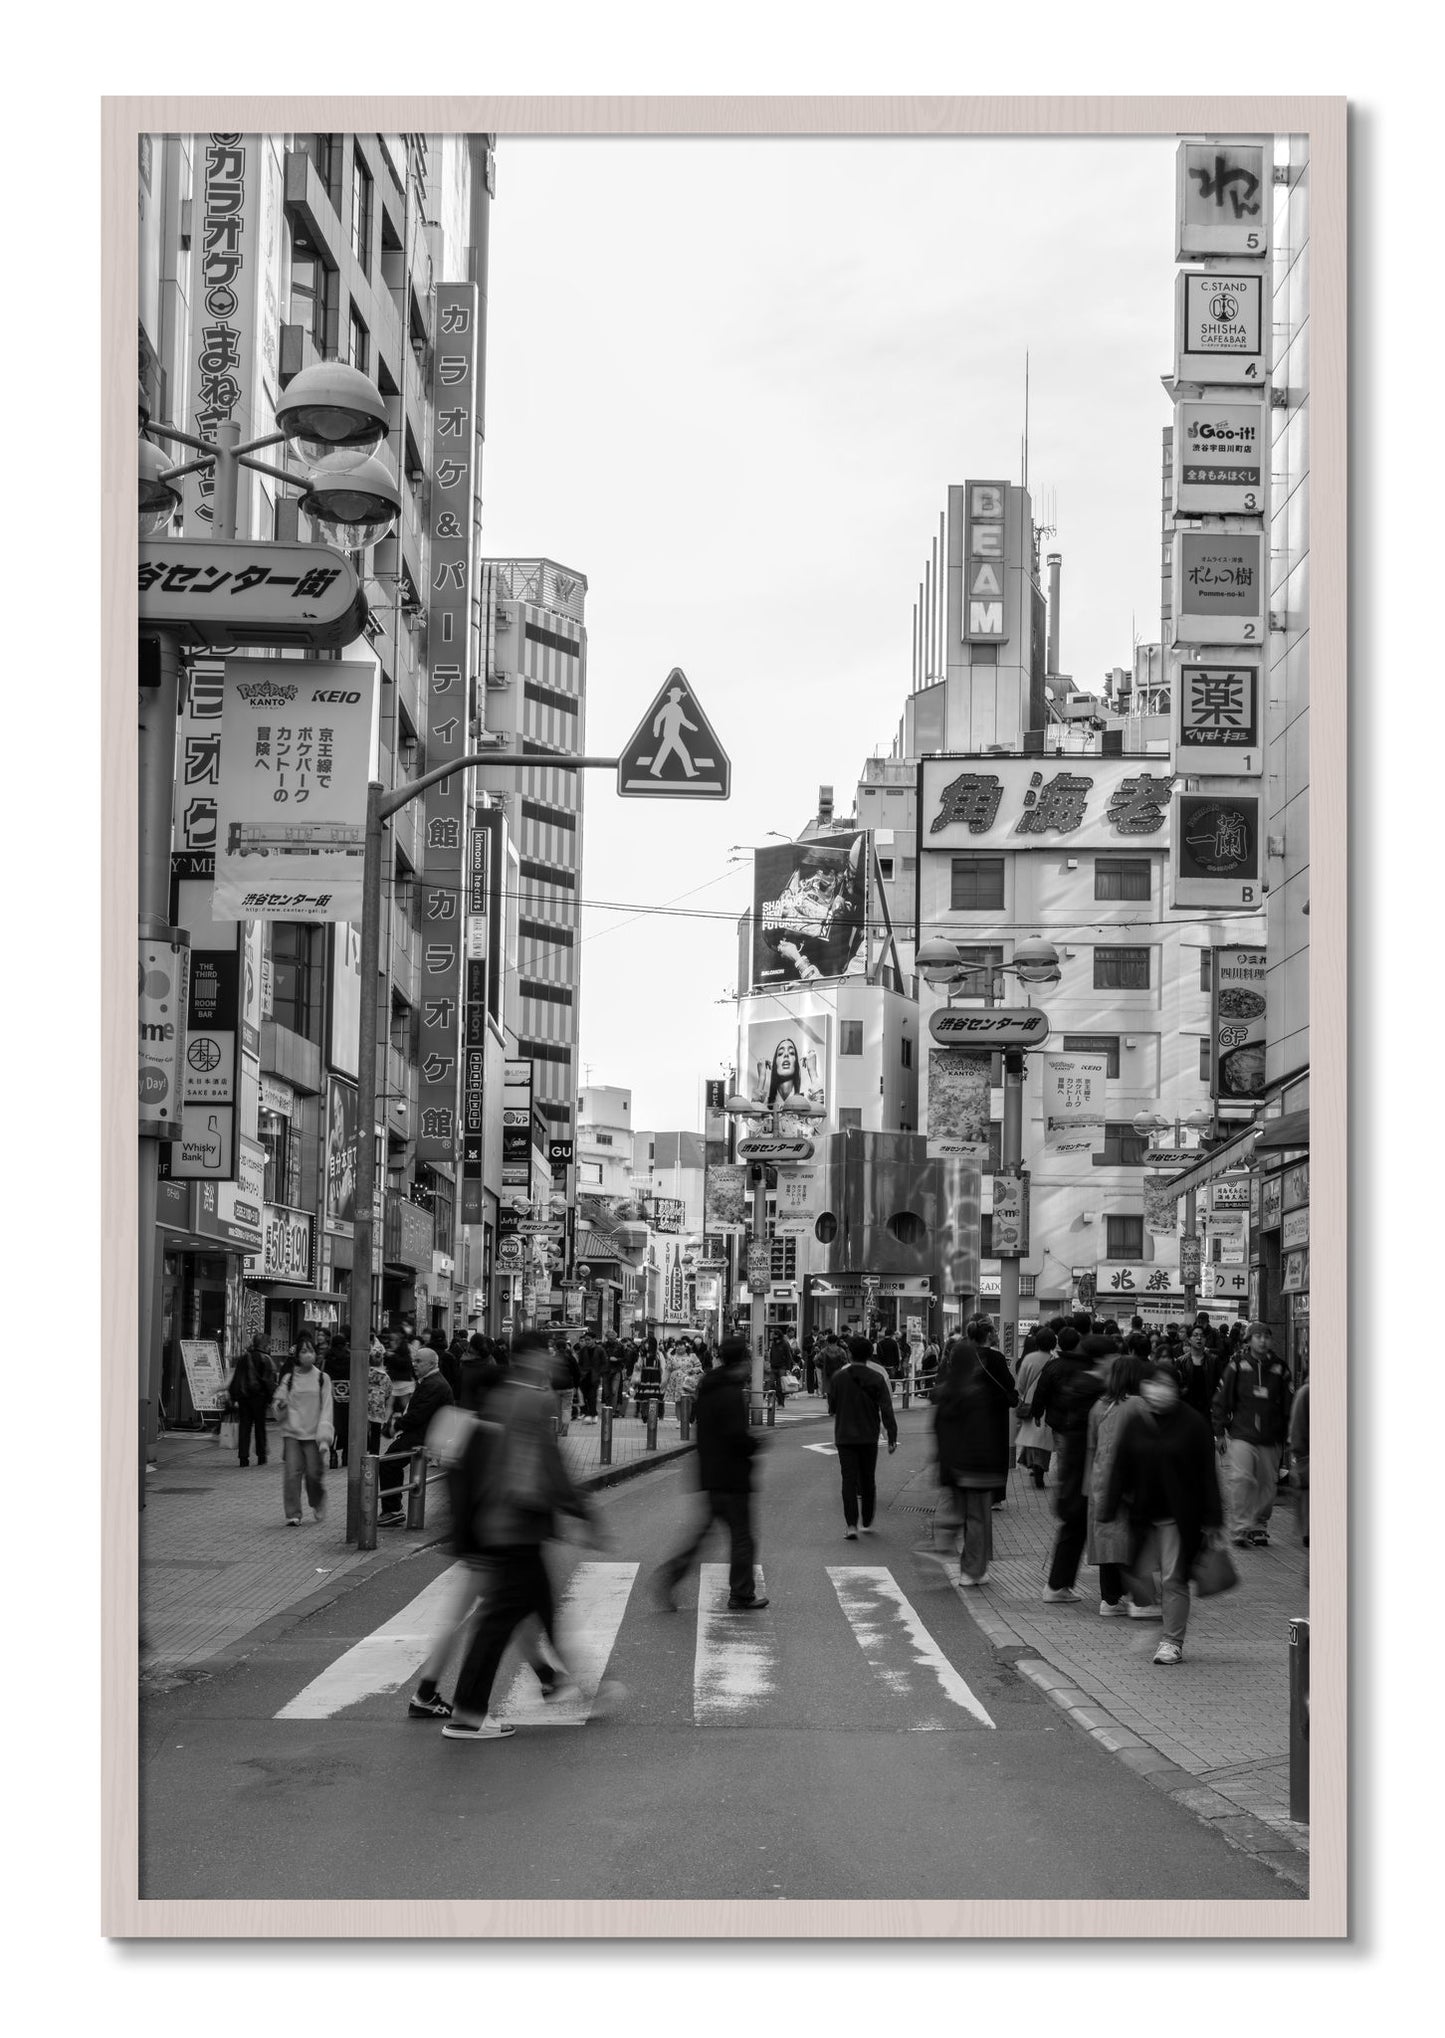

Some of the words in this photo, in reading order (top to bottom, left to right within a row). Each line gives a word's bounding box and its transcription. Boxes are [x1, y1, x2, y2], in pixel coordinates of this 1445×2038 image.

[202, 146, 246, 288] カラオケ
[1246, 233, 1259, 249] 5
[1201, 282, 1247, 292] C.STAND
[1201, 323, 1247, 334] SHISHA
[1201, 335, 1247, 343] CAFE&BAR
[1245, 363, 1257, 378] 4
[1199, 423, 1256, 440] Goo-it!
[1192, 443, 1252, 453] 渋谷宇田川町店
[1187, 469, 1257, 482] 全身もみほぐし
[1244, 492, 1256, 509] 3
[971, 485, 1003, 635] BEAM
[1243, 623, 1256, 640] 2
[311, 690, 361, 704] KEIO
[1191, 673, 1244, 726] 薬
[1185, 728, 1249, 743] マツモトキヨシ
[254, 726, 271, 770] 冒険へ
[273, 726, 292, 802] カントーの
[294, 726, 313, 802] ポケパーク
[316, 727, 334, 788] 京王線で
[1243, 755, 1252, 771] 1
[929, 771, 1175, 835] 角海老
[1185, 811, 1248, 862] 一蘭
[474, 832, 483, 869] kimono
[241, 893, 333, 907] 渋谷センター街
[1242, 886, 1254, 903] B
[1221, 967, 1265, 979] 四川料理
[936, 1017, 1042, 1031] 渋谷センター街
[1219, 1026, 1248, 1047] 6F
[516, 1116, 528, 1124] UP
[183, 1143, 216, 1154] Whisky
[551, 1146, 572, 1157] GU
[182, 1153, 202, 1161] Bank
[672, 1267, 681, 1310] BEER
